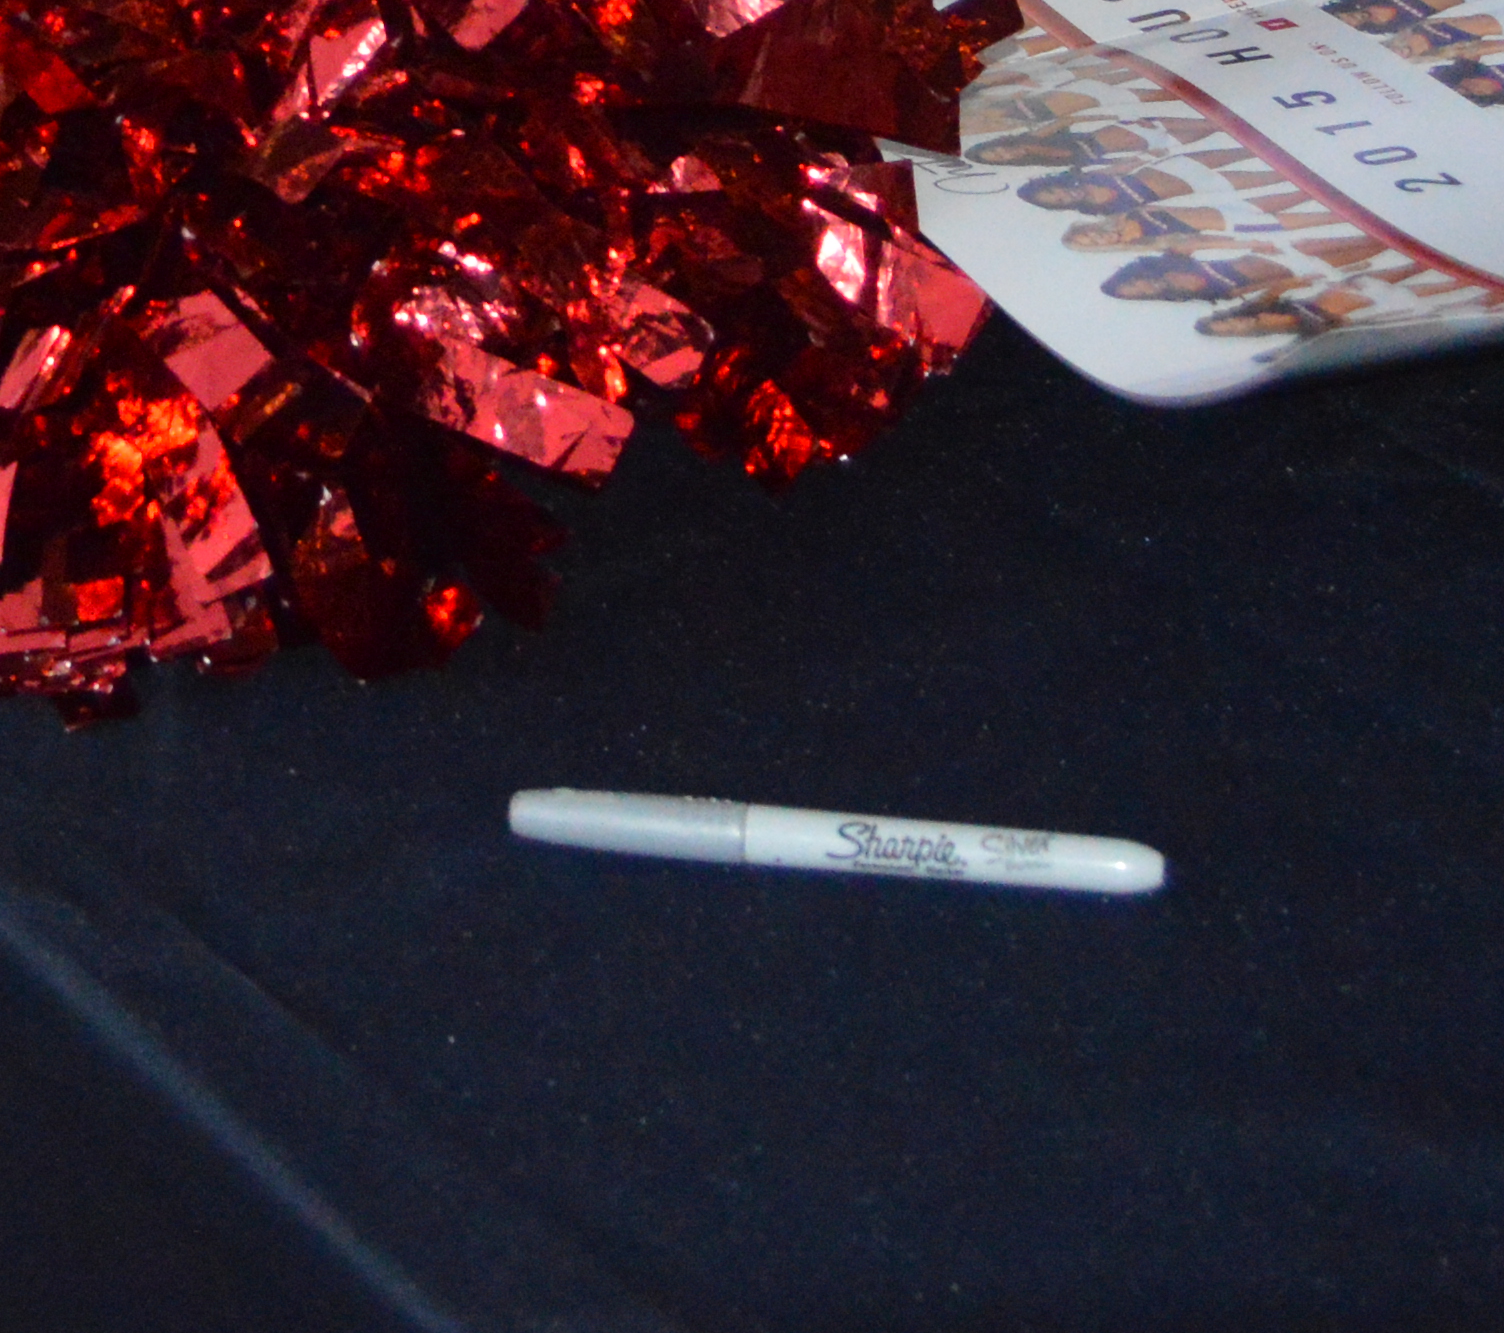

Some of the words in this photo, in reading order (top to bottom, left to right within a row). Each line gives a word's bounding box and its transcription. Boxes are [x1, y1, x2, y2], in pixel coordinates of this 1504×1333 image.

[1331, 57, 1358, 69] US
[1351, 71, 1412, 105] FOLLOW
[1272, 88, 1465, 196] 2015
[826, 822, 958, 865] Sharpie
